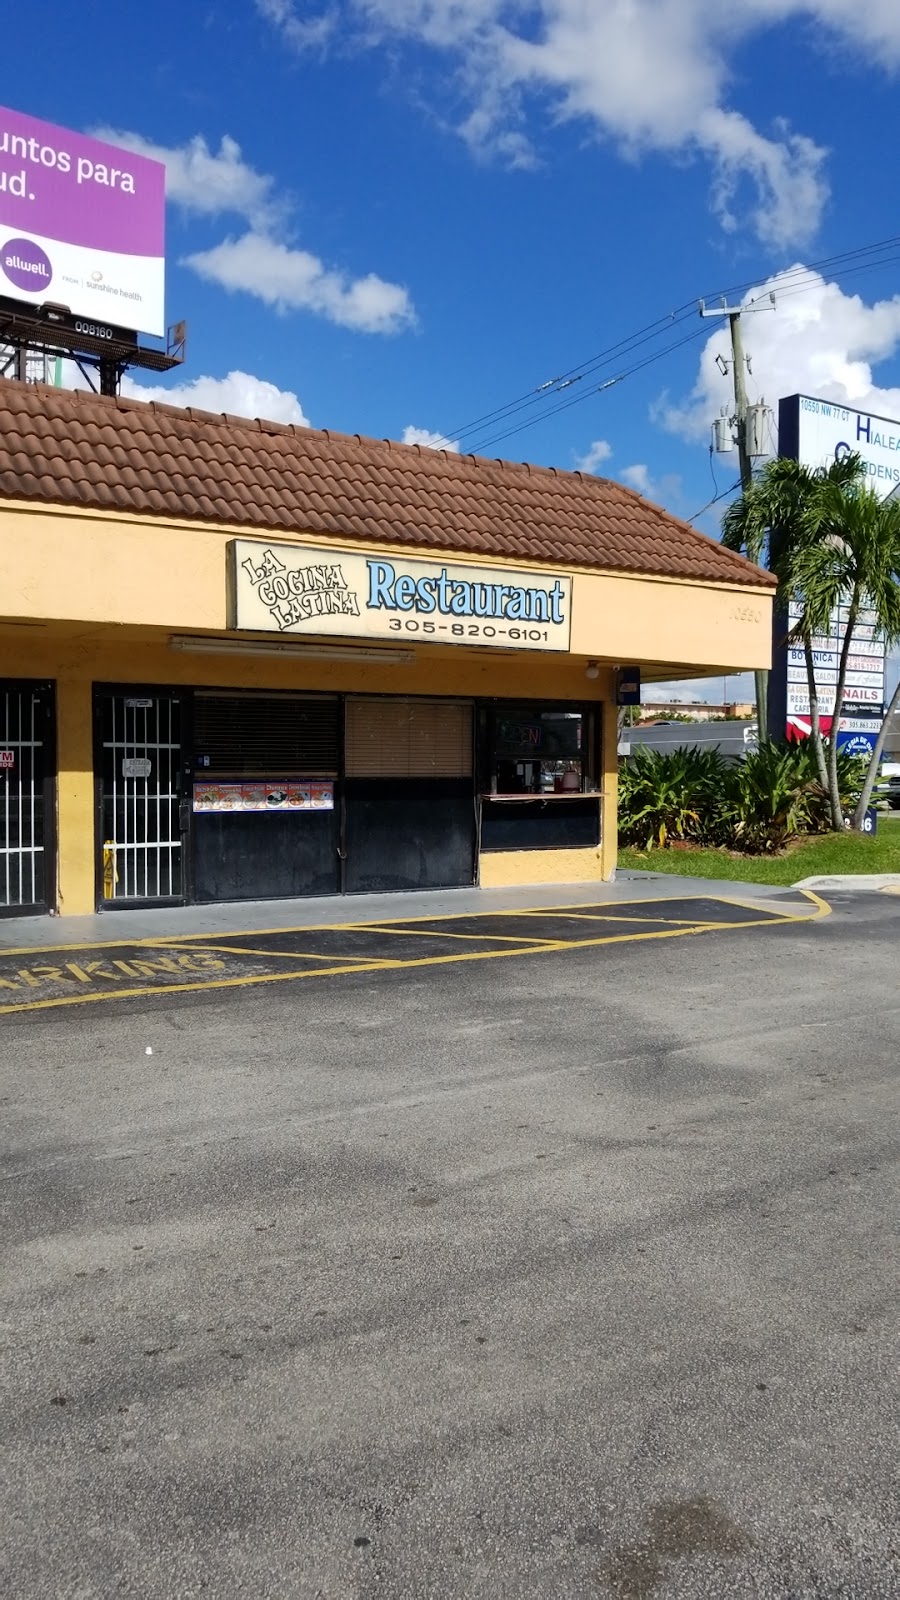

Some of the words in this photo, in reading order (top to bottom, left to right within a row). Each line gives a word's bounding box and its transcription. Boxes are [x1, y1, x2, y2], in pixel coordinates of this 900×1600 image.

[77, 157, 136, 194] para
[5, 256, 49, 277] allwell.
[62, 275, 79, 284] FROM
[86, 280, 119, 295] sunshine
[119, 288, 142, 301] health
[75, 321, 113, 339] 008160
[801, 400, 820, 414] 10550
[821, 405, 832, 417] NW
[833, 408, 841, 418] 77
[841, 411, 850, 422] CT
[241, 549, 286, 585] LA
[259, 564, 348, 606] COCINA
[365, 559, 565, 625] Restaurant
[270, 590, 361, 631] LATINA
[388, 618, 549, 642] 305-820-6101
[791, 651, 833, 662] BONICA
[846, 662, 880, 671] 5-819-1717
[788, 670, 808, 679] BEAUT
[815, 672, 835, 681] SALON
[790, 695, 834, 704] RESTRANT
[843, 689, 878, 700] NAILS
[794, 704, 829, 713] CAFERIA
